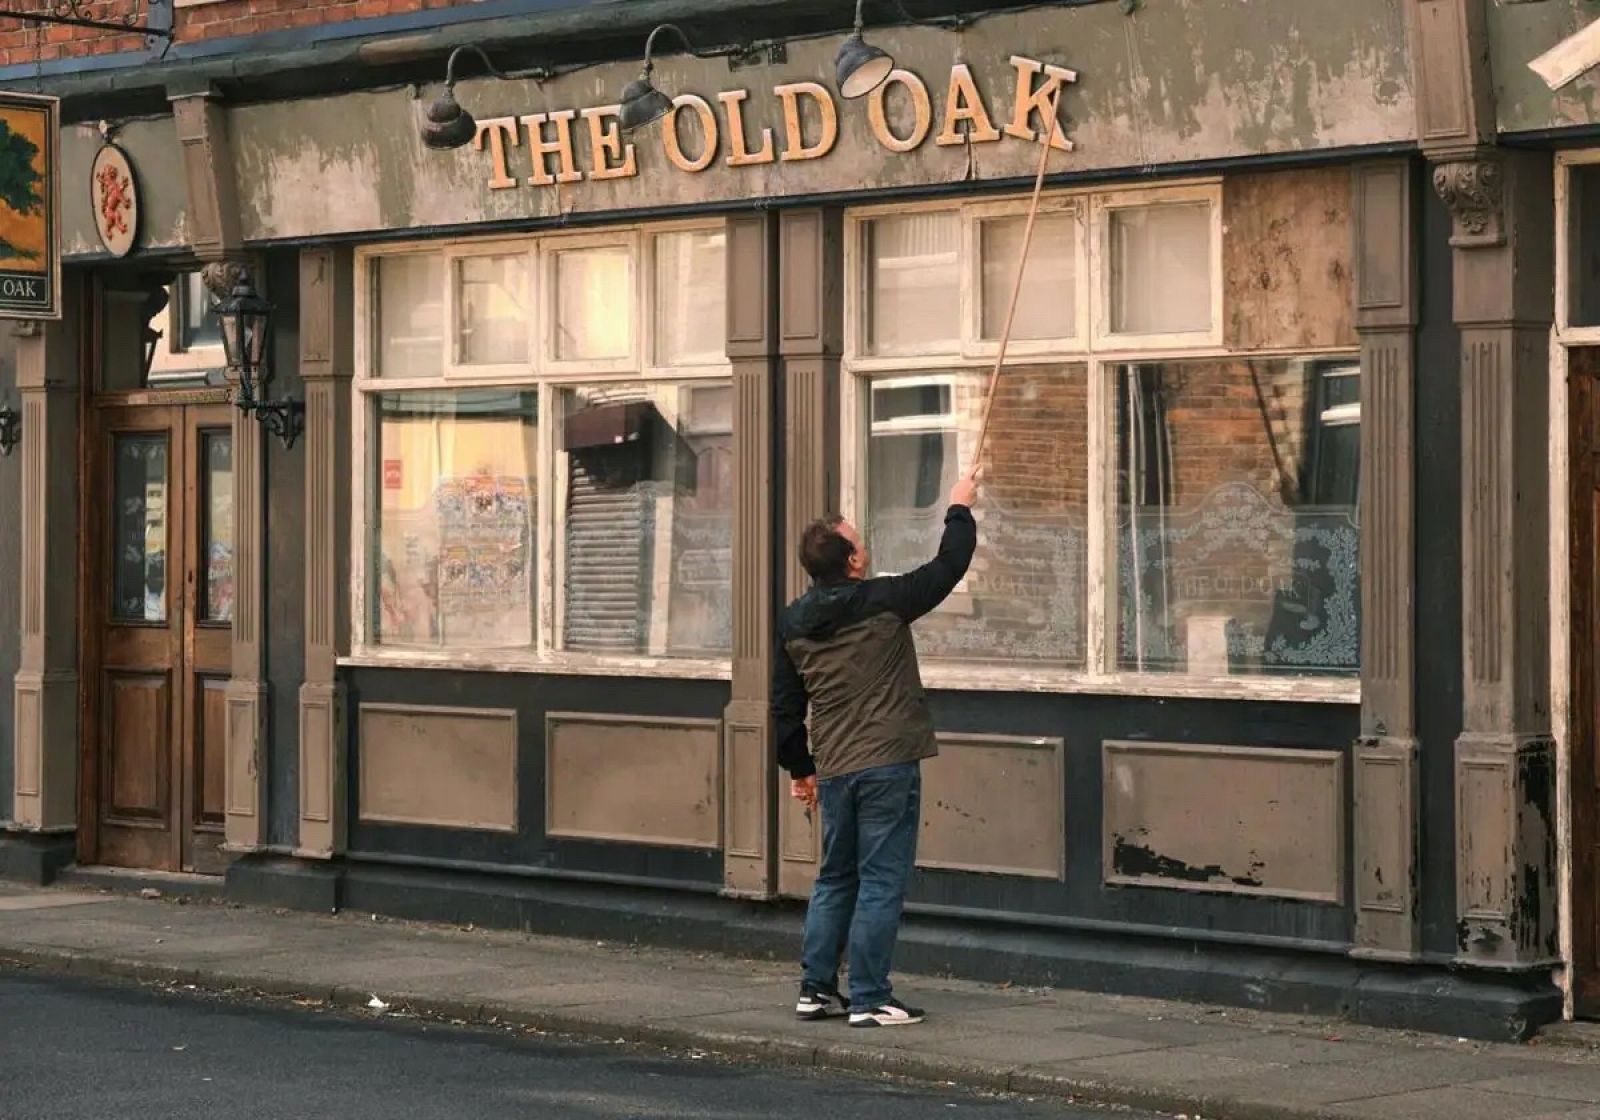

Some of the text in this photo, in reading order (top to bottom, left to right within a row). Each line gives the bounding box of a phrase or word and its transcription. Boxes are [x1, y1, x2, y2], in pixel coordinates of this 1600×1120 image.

[472, 55, 1077, 189] THE OLD OAK
[3, 279, 37, 298] OAK
